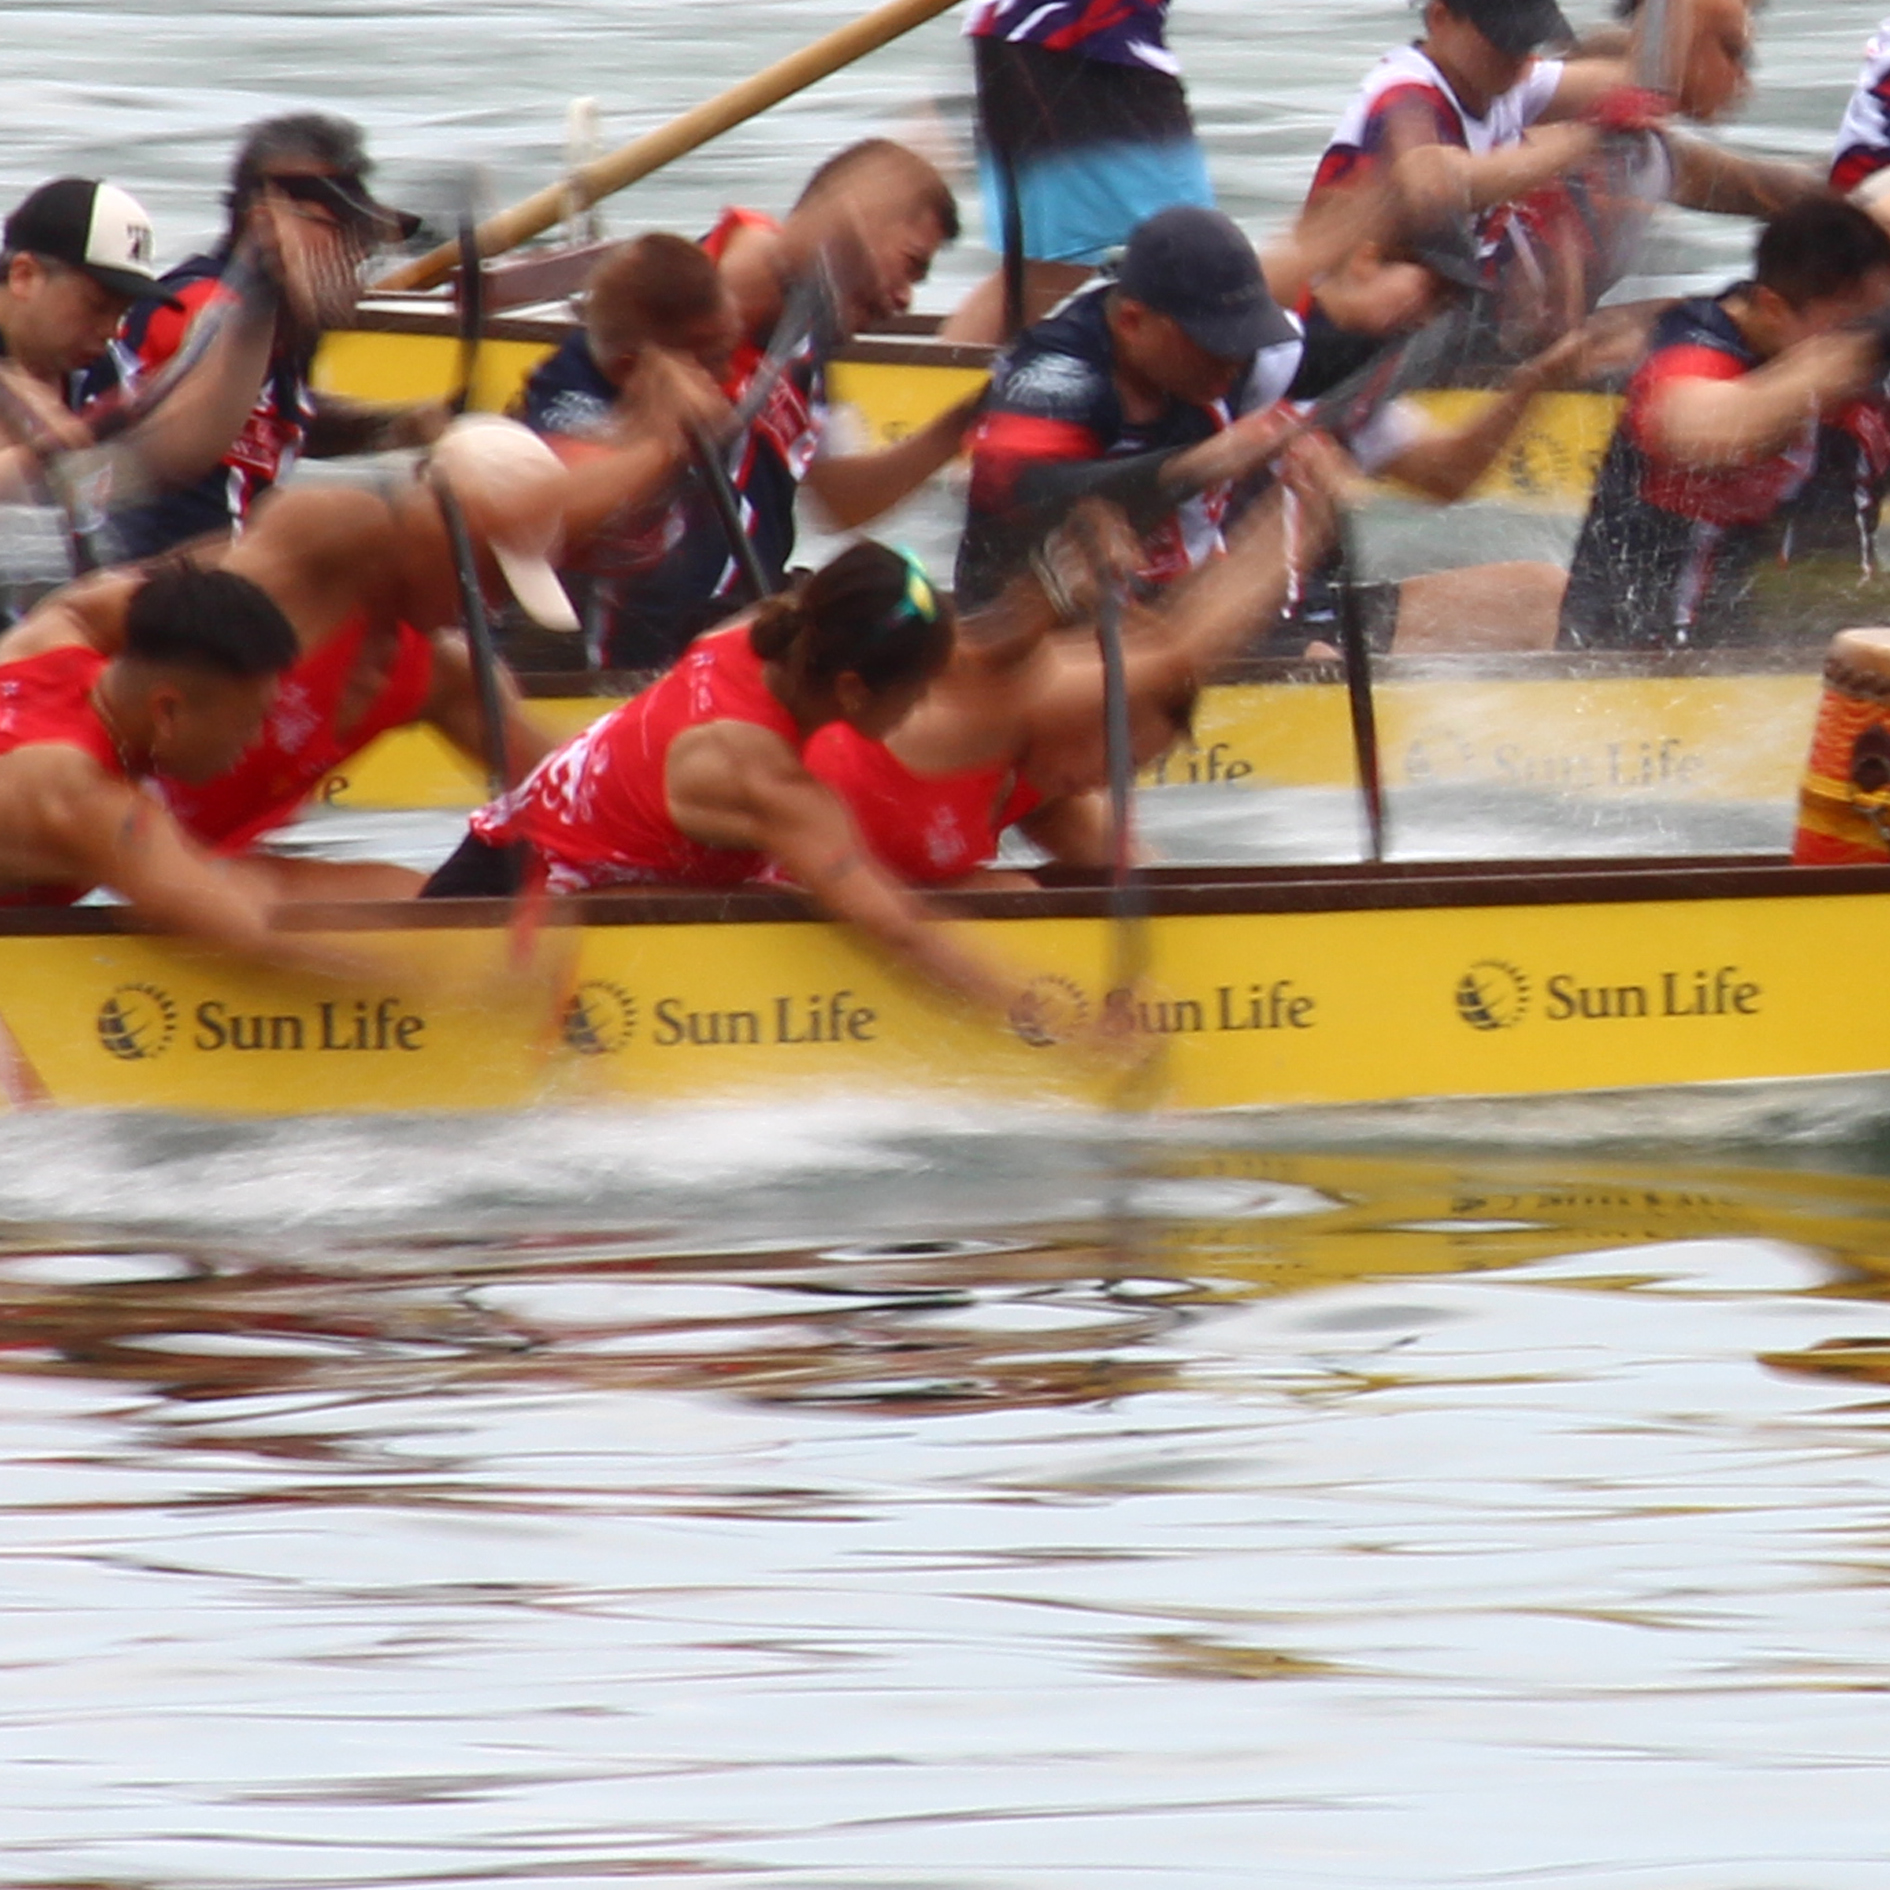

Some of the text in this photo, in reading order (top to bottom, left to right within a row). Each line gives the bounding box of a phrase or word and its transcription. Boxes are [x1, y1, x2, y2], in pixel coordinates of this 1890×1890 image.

[653, 990, 878, 1046] Sun Life
[1215, 980, 1315, 1031] Life
[1545, 966, 1761, 1021] Sun Life
[194, 998, 426, 1052] Sun Life
